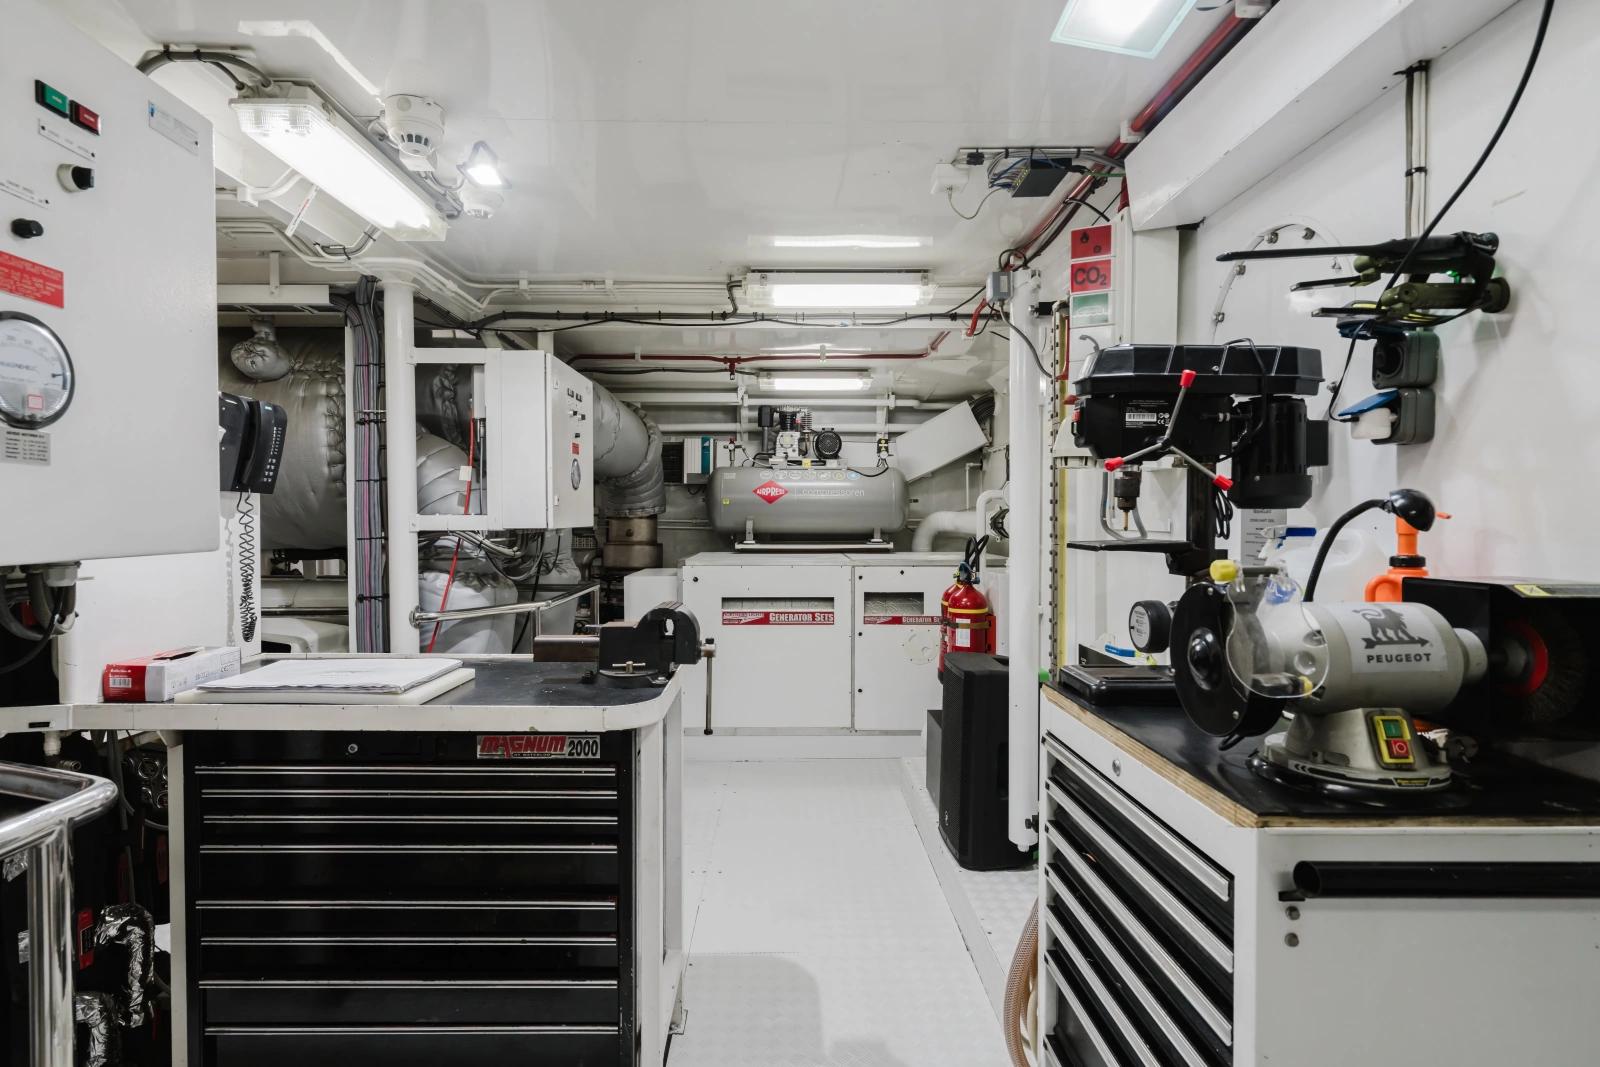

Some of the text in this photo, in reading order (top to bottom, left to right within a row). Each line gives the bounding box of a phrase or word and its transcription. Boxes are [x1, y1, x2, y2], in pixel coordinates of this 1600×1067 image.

[802, 488, 865, 498] compressoren
[814, 612, 834, 622] SETS
[1366, 653, 1432, 664] PEUGEOT
[480, 735, 599, 758] MAGNUM 2000
